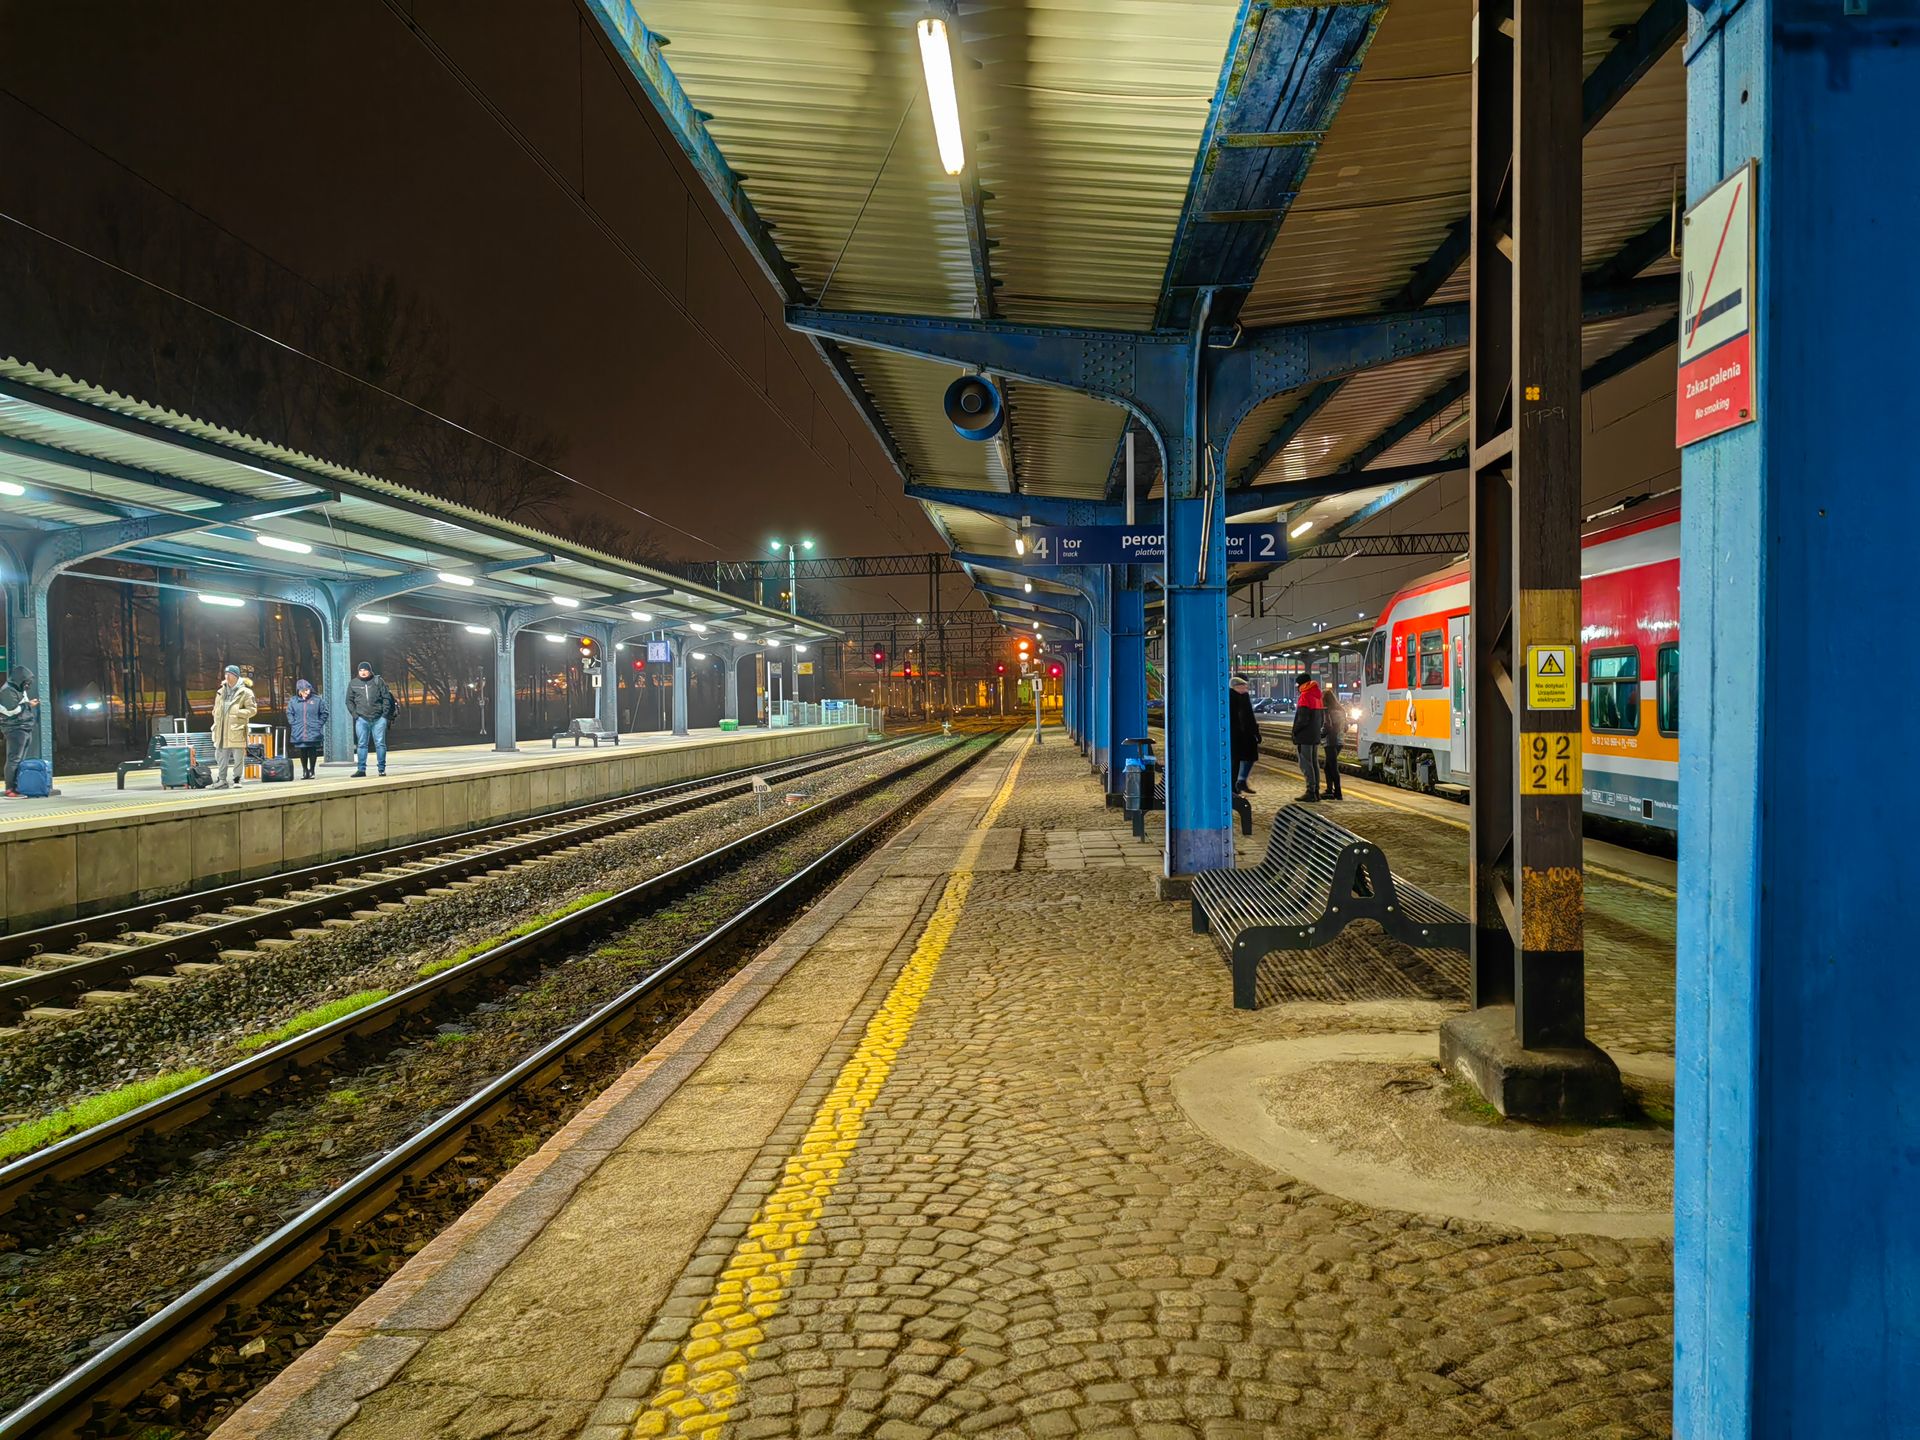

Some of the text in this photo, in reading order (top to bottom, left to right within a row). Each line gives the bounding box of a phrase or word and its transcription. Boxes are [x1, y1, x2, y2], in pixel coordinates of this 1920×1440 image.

[1685, 362, 1742, 399] Zakaz palenia
[1694, 398, 1731, 420] No smoking
[1032, 537, 1049, 559] 4
[1063, 538, 1082, 549] tor
[1225, 536, 1245, 546] tor
[1259, 533, 1276, 556] 2
[1062, 550, 1079, 558] track
[1532, 736, 1571, 760] 92
[1532, 763, 1571, 789] 24
